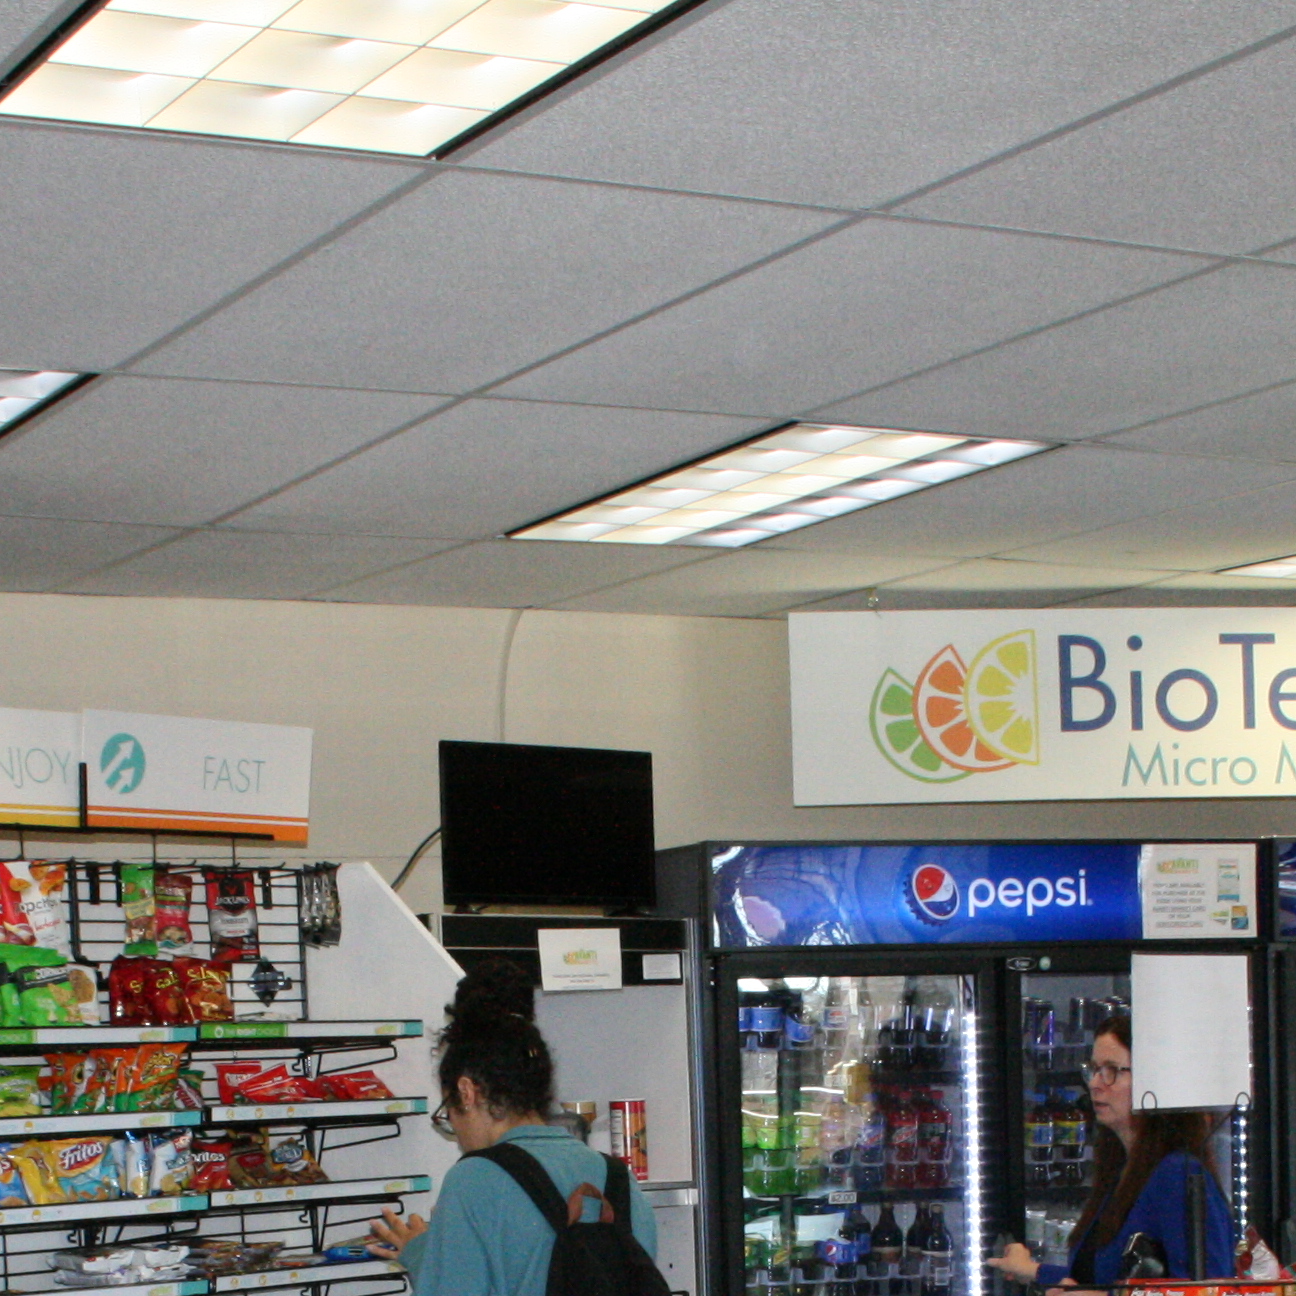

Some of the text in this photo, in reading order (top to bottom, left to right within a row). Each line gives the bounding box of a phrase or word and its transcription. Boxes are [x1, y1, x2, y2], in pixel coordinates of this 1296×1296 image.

[204, 756, 266, 793] FAST
[1122, 741, 1257, 787] Micro
[968, 868, 1088, 917] pepsi
[58, 1141, 104, 1171] Fritos
[187, 1151, 225, 1164] oritos
